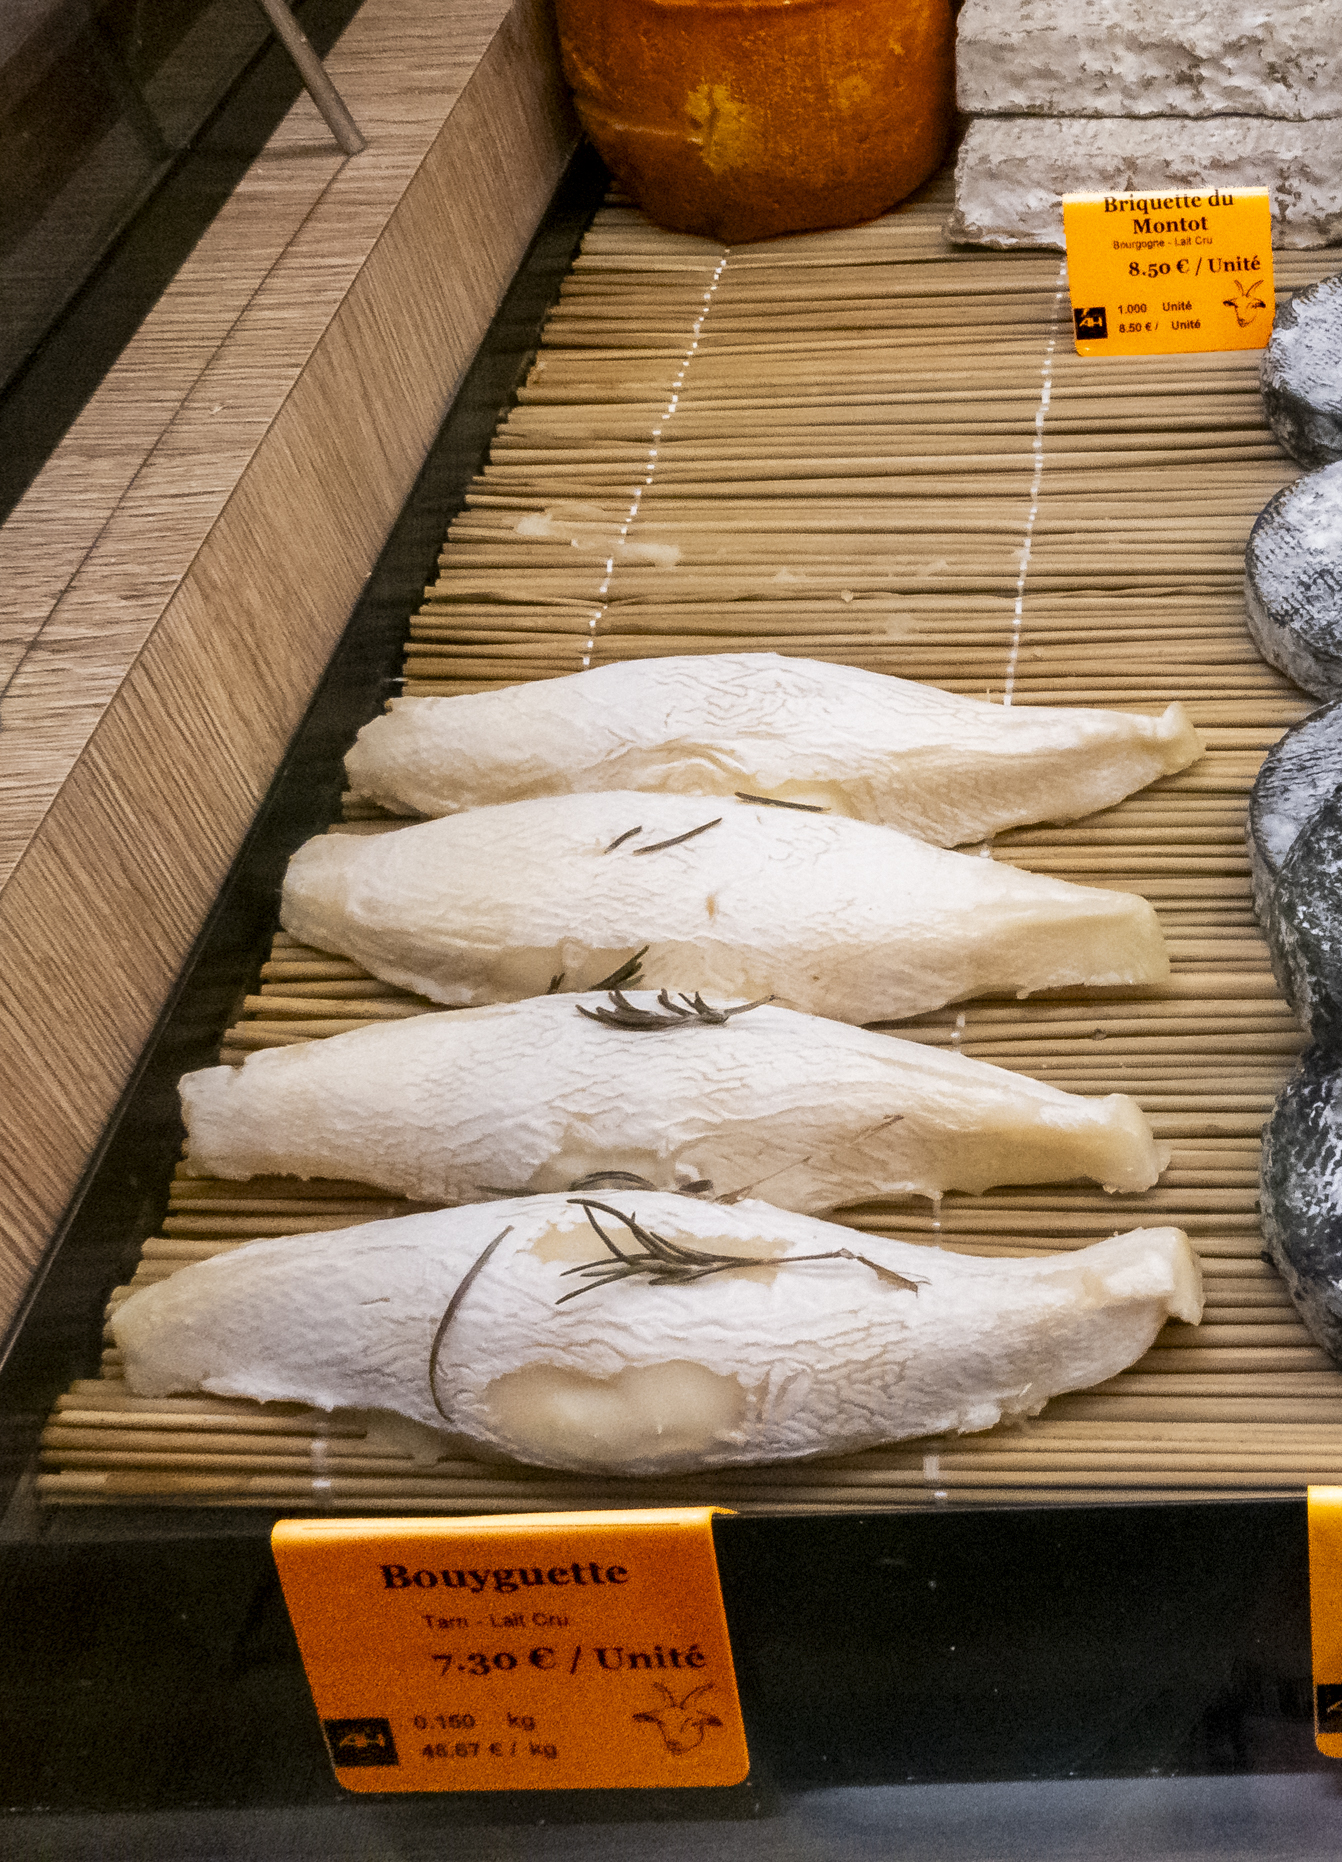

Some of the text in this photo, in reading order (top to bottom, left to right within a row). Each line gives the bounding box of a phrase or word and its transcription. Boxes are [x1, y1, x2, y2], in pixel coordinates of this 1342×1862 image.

[1104, 189, 1234, 214] Briquette du
[1133, 216, 1209, 234] Montot
[1113, 238, 1165, 250] Bourgogne
[1175, 237, 1192, 246] Lait
[1194, 236, 1213, 245] Cru
[1128, 255, 1261, 278] 8.50 € / Unité
[1117, 301, 1192, 314] 1.000 Unité
[1119, 323, 1142, 333] 8.50
[1145, 322, 1152, 331] €
[1171, 319, 1201, 330] Unité
[380, 1560, 628, 1593] Bouyguette
[422, 1614, 468, 1628] Tarn
[490, 1613, 526, 1627] Lait
[532, 1612, 569, 1627] Cru
[432, 1646, 705, 1676] 7.30 € / Unité
[507, 1712, 536, 1731] kg
[529, 1742, 557, 1759] kg
